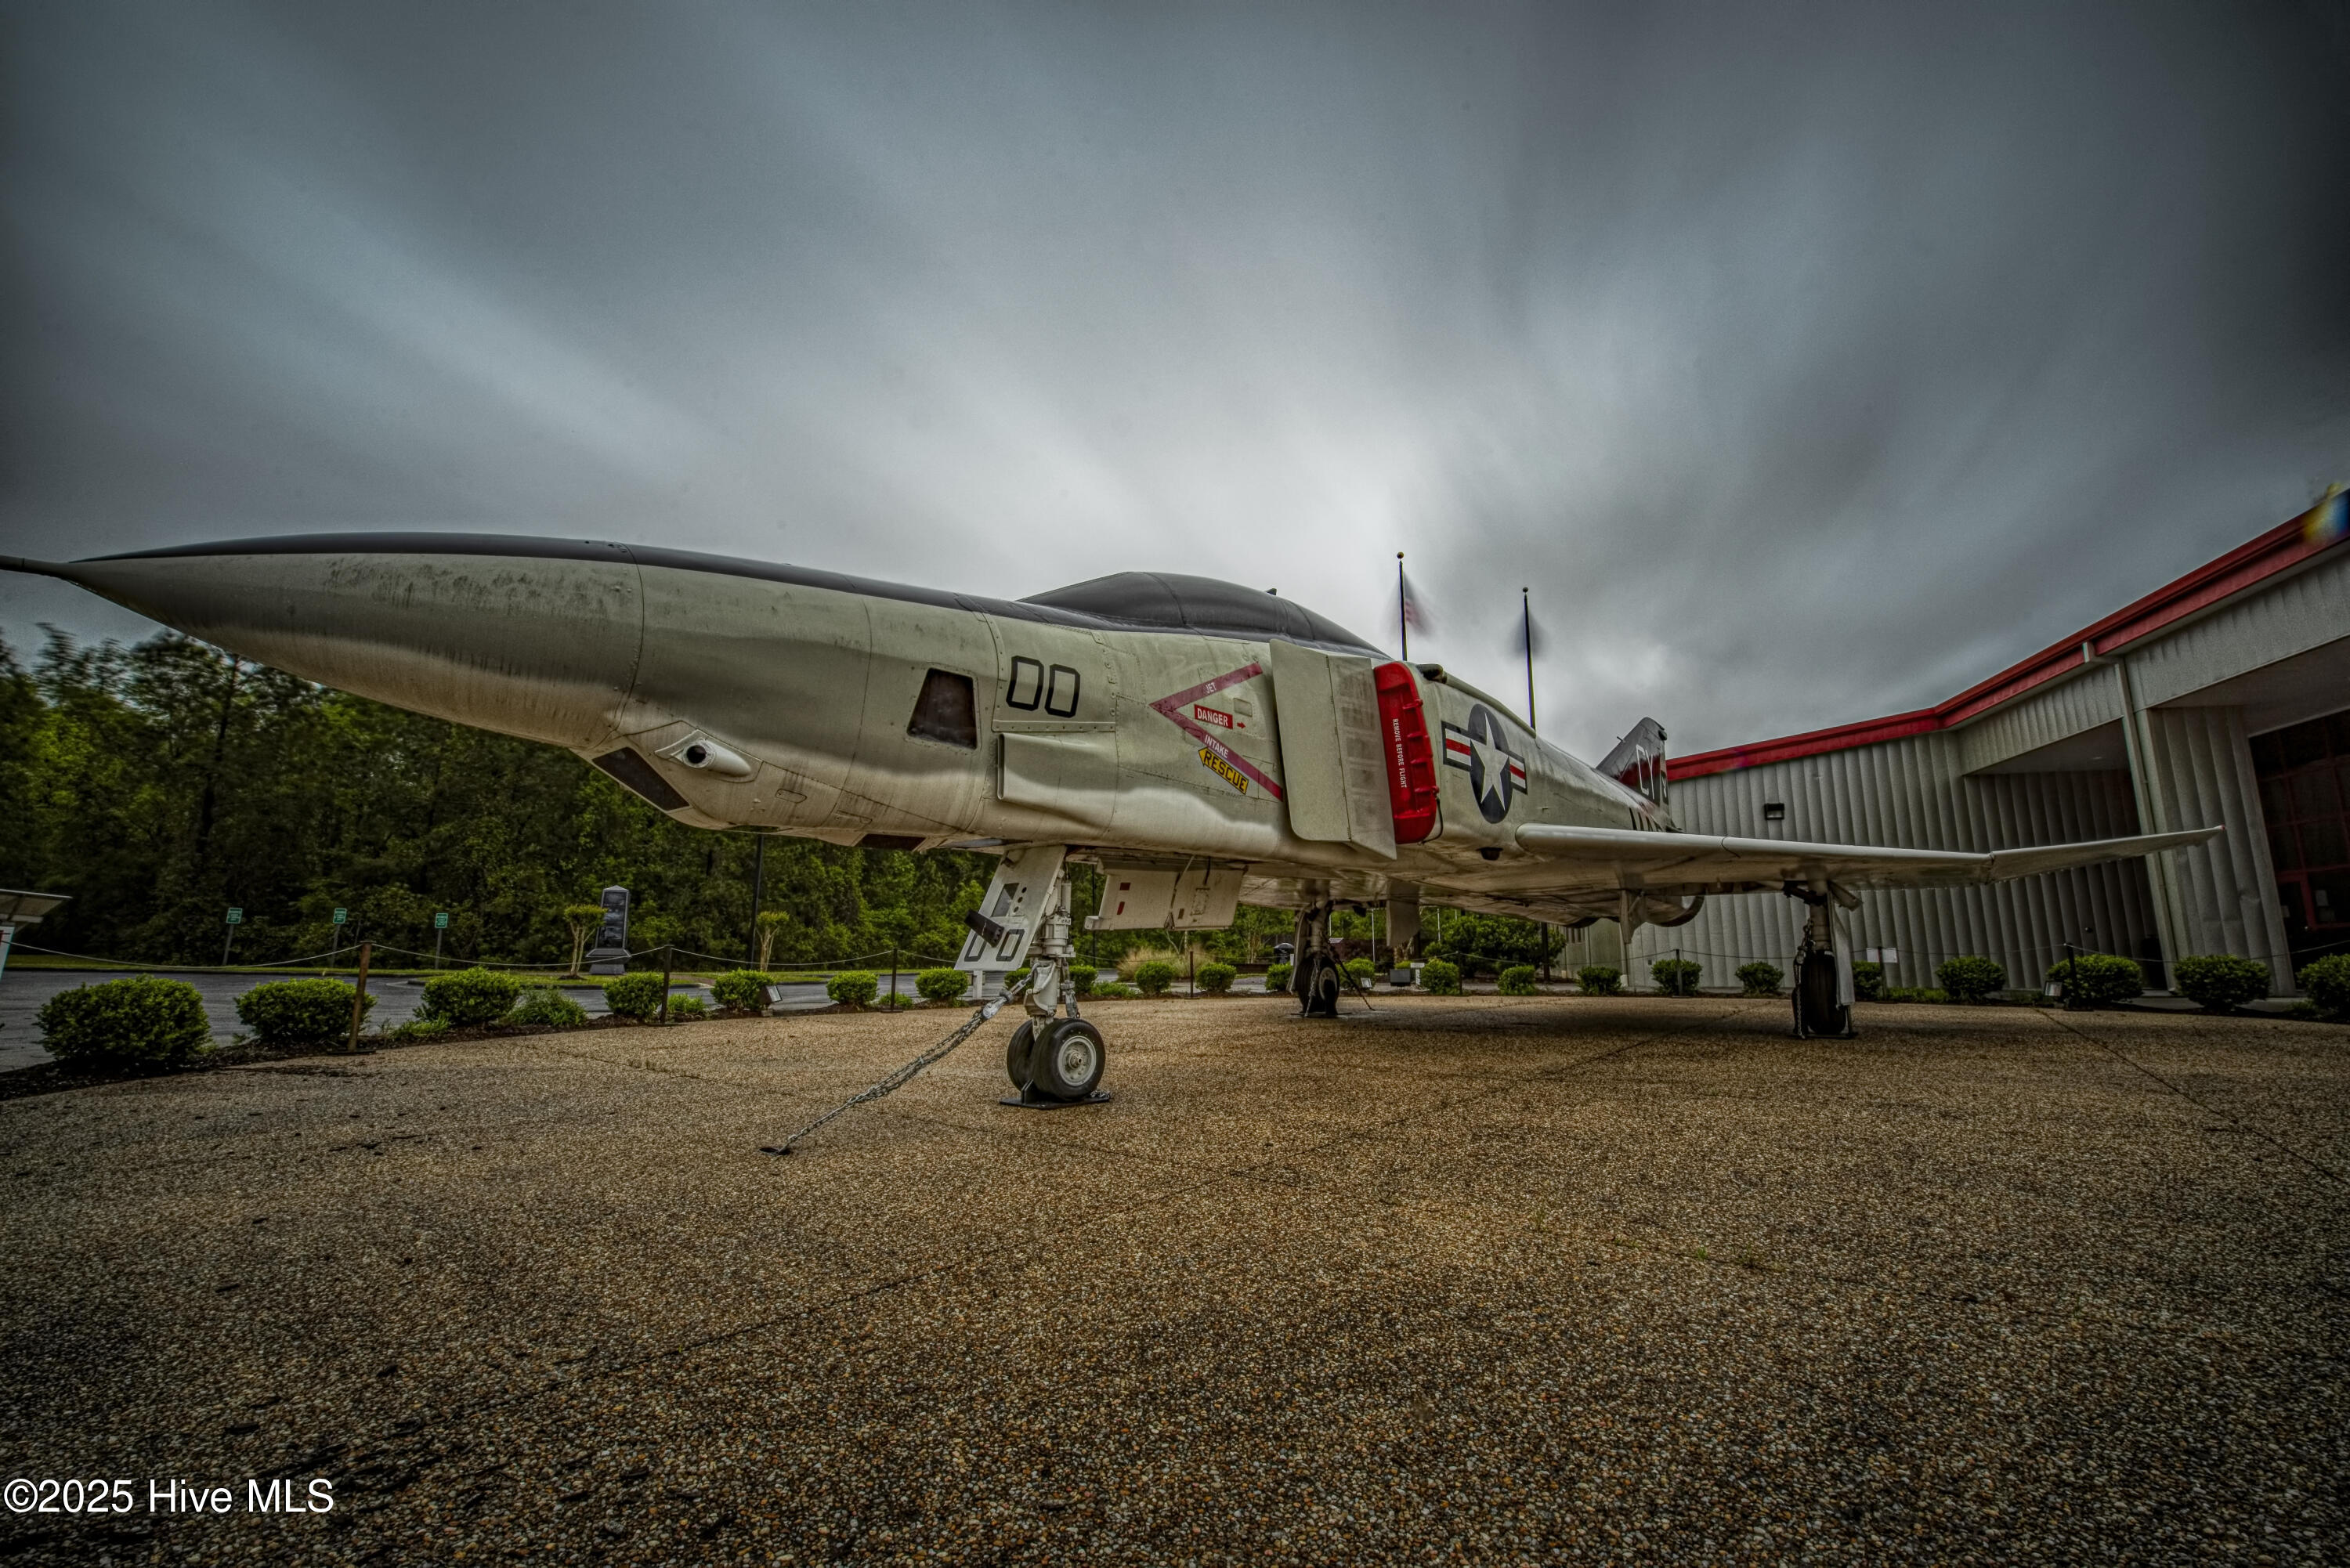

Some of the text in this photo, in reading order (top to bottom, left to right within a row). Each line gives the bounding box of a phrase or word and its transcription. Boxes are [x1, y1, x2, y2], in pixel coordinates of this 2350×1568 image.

[1205, 681, 1217, 694] JET
[1197, 707, 1228, 727] DANGER
[1205, 734, 1228, 759] INTAKE
[1392, 718, 1408, 788] REMOVE BEFORE FLIGHT
[1203, 750, 1247, 792] RESCUE
